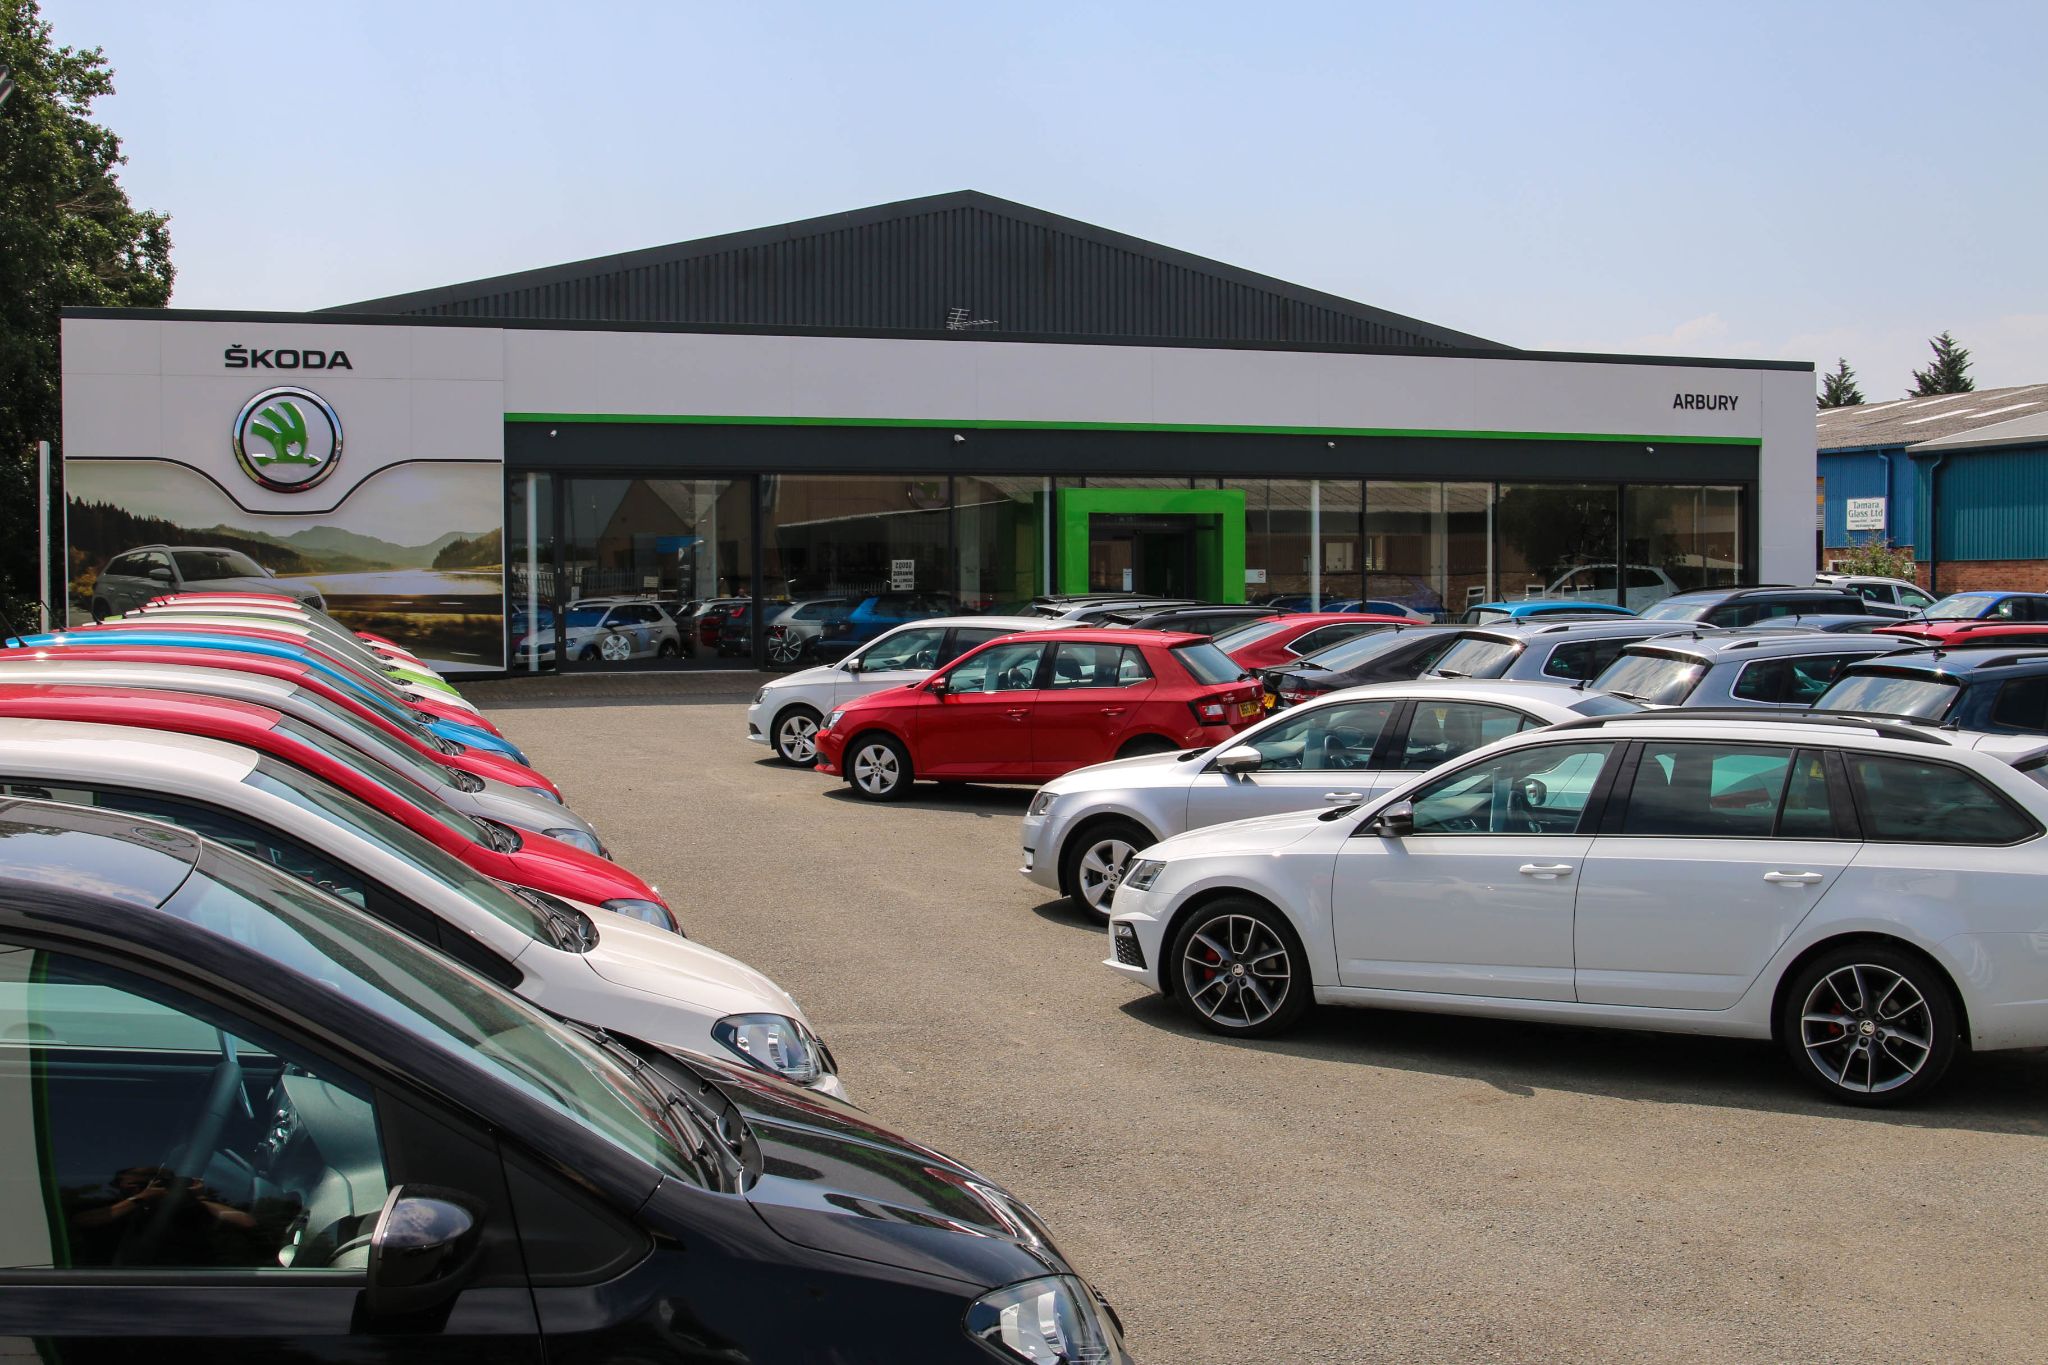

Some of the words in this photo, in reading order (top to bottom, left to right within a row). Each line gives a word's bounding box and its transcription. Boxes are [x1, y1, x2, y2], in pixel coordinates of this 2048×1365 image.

[224, 344, 353, 370] ŠKODA
[1673, 393, 1739, 411] ARBURY
[1853, 501, 1880, 509] Tamara
[1848, 509, 1869, 518] Glass
[1870, 508, 1883, 517] Ltd
